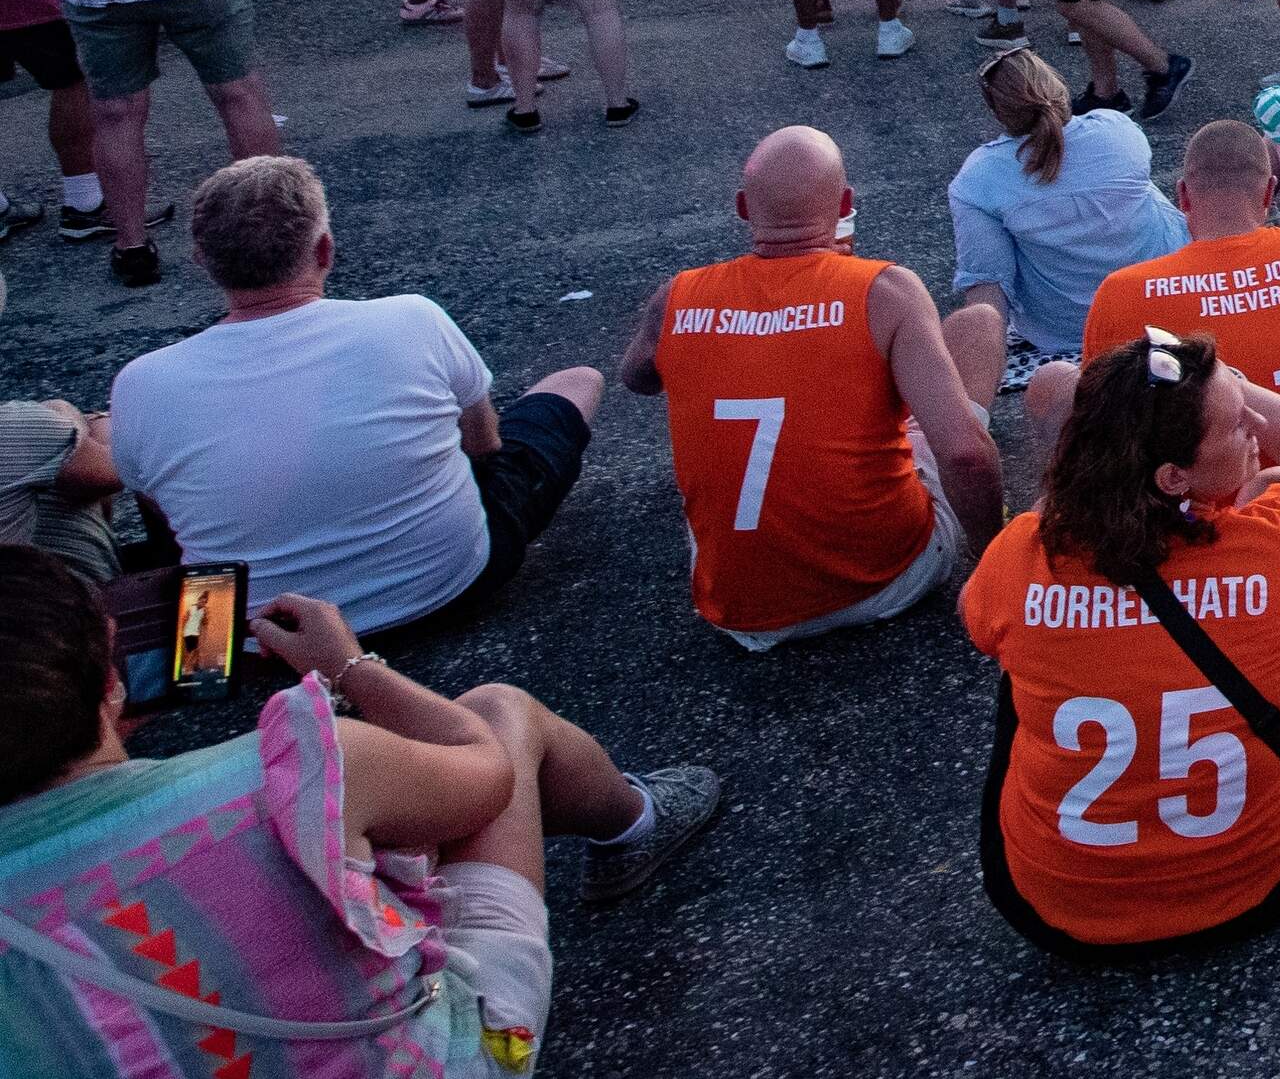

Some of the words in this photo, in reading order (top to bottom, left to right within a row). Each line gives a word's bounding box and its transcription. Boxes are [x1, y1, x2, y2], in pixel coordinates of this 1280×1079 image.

[1144, 273, 1230, 299] FRENKIE
[1232, 266, 1260, 290] DE
[672, 308, 716, 335] XAVI
[715, 300, 845, 336] SIMONCELLO
[713, 397, 786, 531] 7
[1024, 582, 1161, 629] BORREL
[1172, 573, 1269, 620] HATO
[1053, 684, 1249, 847] 25
